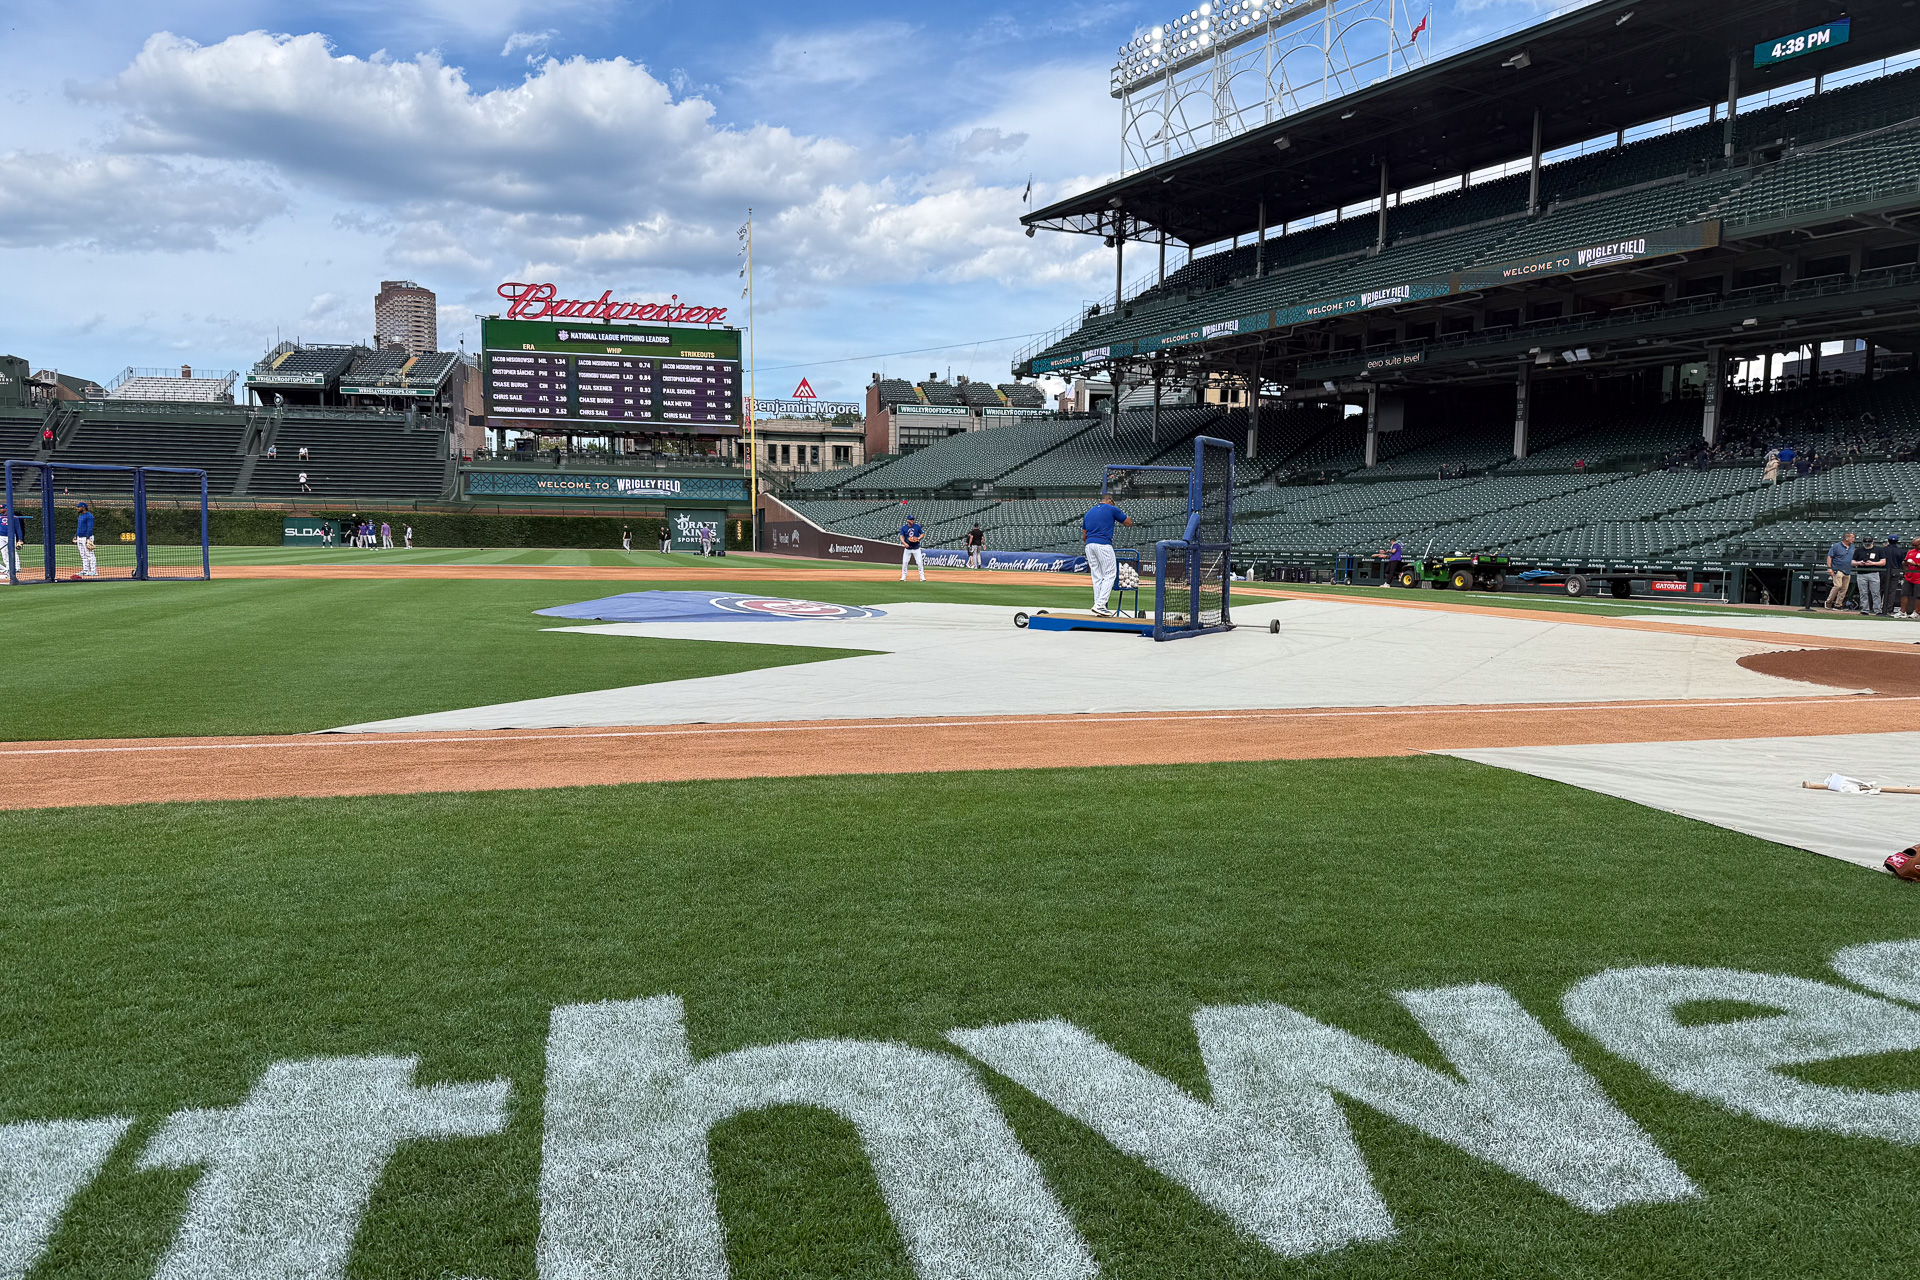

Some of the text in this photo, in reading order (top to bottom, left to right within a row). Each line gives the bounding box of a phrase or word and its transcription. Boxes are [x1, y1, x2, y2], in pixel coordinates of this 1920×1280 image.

[1771, 28, 1831, 58] 4:38 PM
[1503, 239, 1646, 277] WELCOME TO WRIGLEY FIELD
[497, 282, 728, 324] Budweiser
[1307, 285, 1410, 316] WELCOME TO WRIGLEY FIELD
[570, 332, 598, 340] NATIONAL
[598, 333, 620, 341] LEAGUE
[646, 336, 670, 344] LEADERS
[1162, 334, 1188, 344] WELCOME
[1202, 322, 1224, 338] WRIGLEY
[1224, 320, 1238, 331] FIELD
[1051, 358, 1072, 366] WELCOME
[1368, 352, 1420, 368] eero suite level
[750, 399, 859, 414] Benjamin Moore
[537, 480, 591, 489] WELCOME
[616, 478, 656, 491] WRIGLEY
[657, 480, 680, 492] FIELD
[285, 528, 324, 536] SLOA
[677, 521, 718, 530] DRAFT
[682, 528, 717, 536] KINS
[835, 543, 852, 553] Invesco
